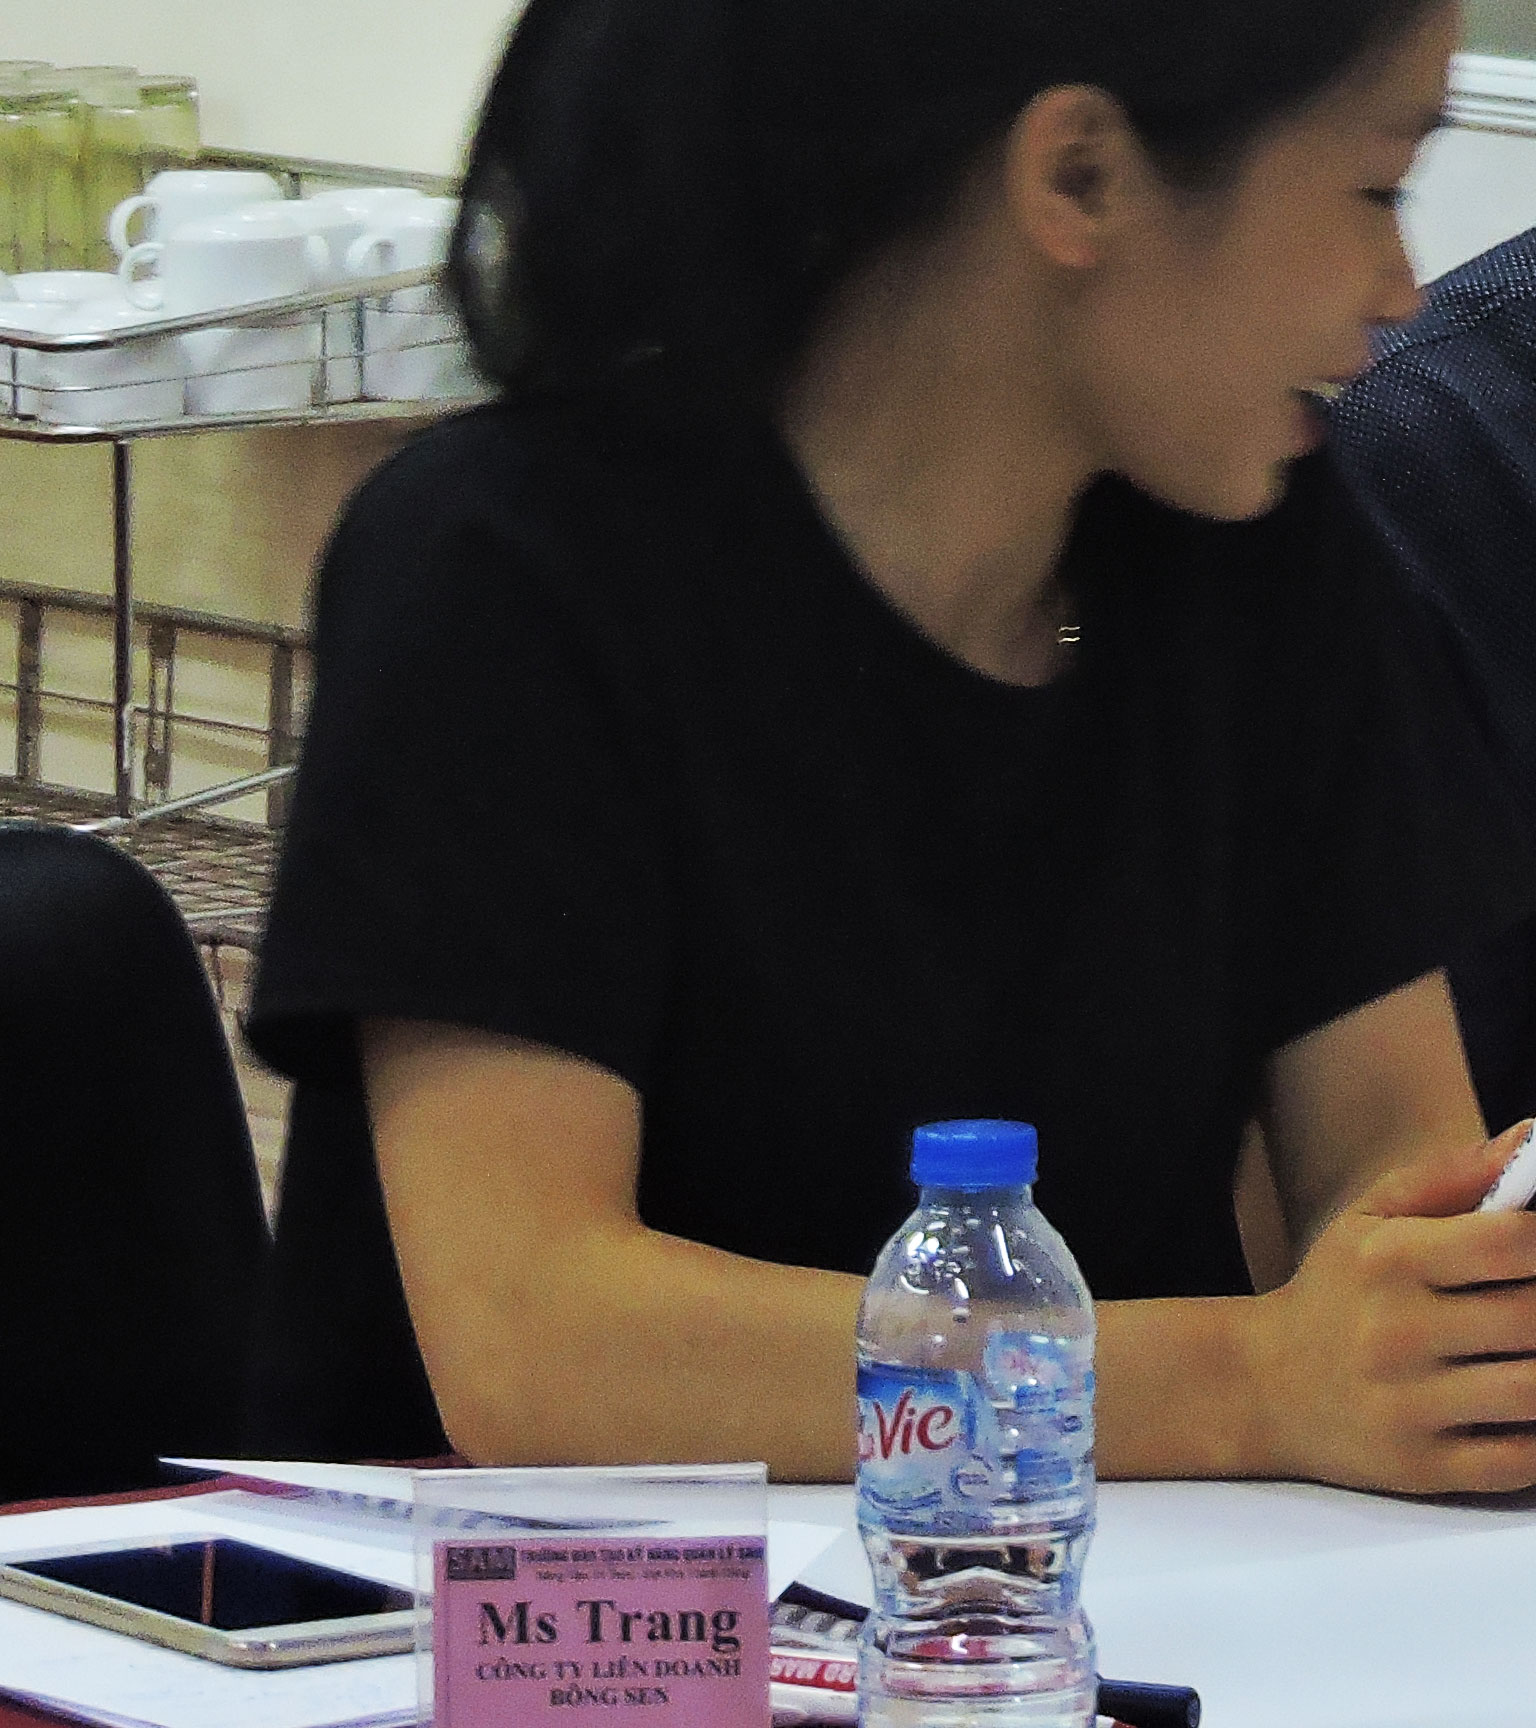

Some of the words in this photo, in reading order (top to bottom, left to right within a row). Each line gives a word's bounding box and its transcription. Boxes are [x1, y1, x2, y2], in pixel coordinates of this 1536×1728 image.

[478, 1600, 558, 1644] Ms
[576, 1600, 742, 1654] Trang
[475, 1656, 547, 1680] CÔNG
[553, 1660, 582, 1680] TY
[655, 1658, 742, 1678] DOANH
[622, 1686, 672, 1706] SEN
